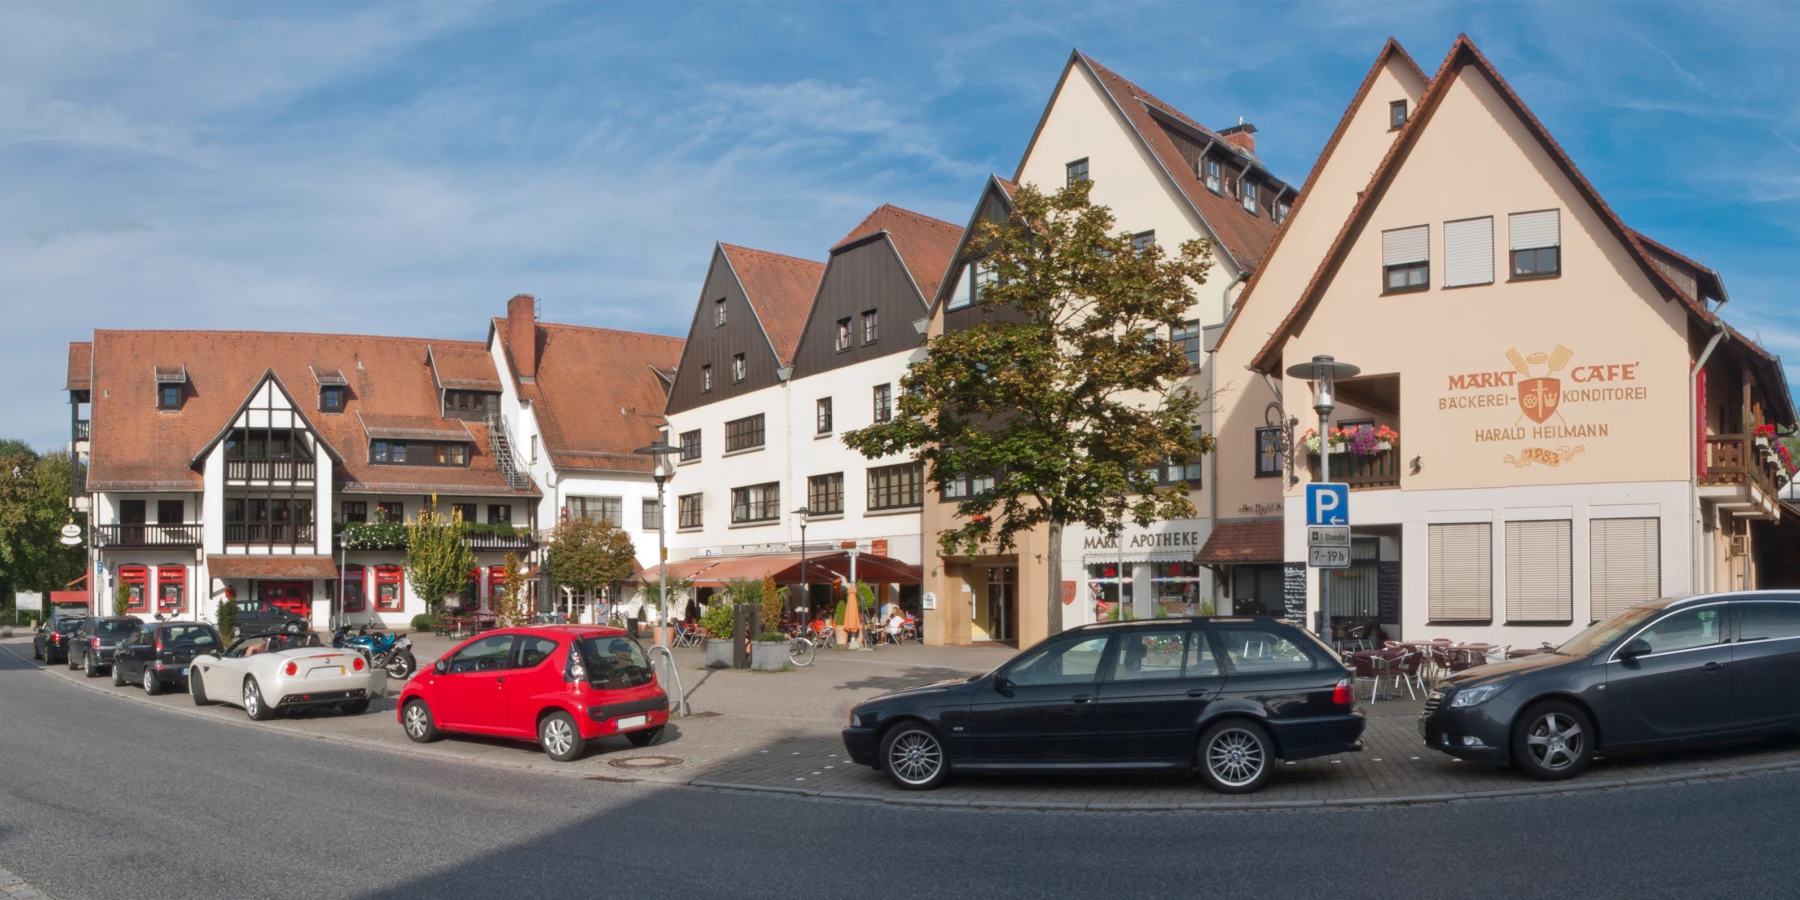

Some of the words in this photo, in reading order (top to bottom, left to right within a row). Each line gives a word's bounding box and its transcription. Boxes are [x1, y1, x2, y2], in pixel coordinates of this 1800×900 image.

[1448, 371, 1517, 390] MARKT
[1438, 393, 1517, 410] BÄCKEREI-
[1562, 387, 1648, 403] KONDITOREI
[1475, 427, 1525, 442] HARALD
[1533, 423, 1609, 439] HEILMANN
[1524, 447, 1559, 464] 1983
[1315, 489, 1339, 523] P
[1084, 535, 1119, 550] MARK
[1130, 532, 1198, 548] APOTHEKE
[1324, 533, 1346, 541] Stunde
[1314, 551, 1320, 562] 7
[1327, 551, 1338, 562] 19
[1339, 551, 1344, 562] h
